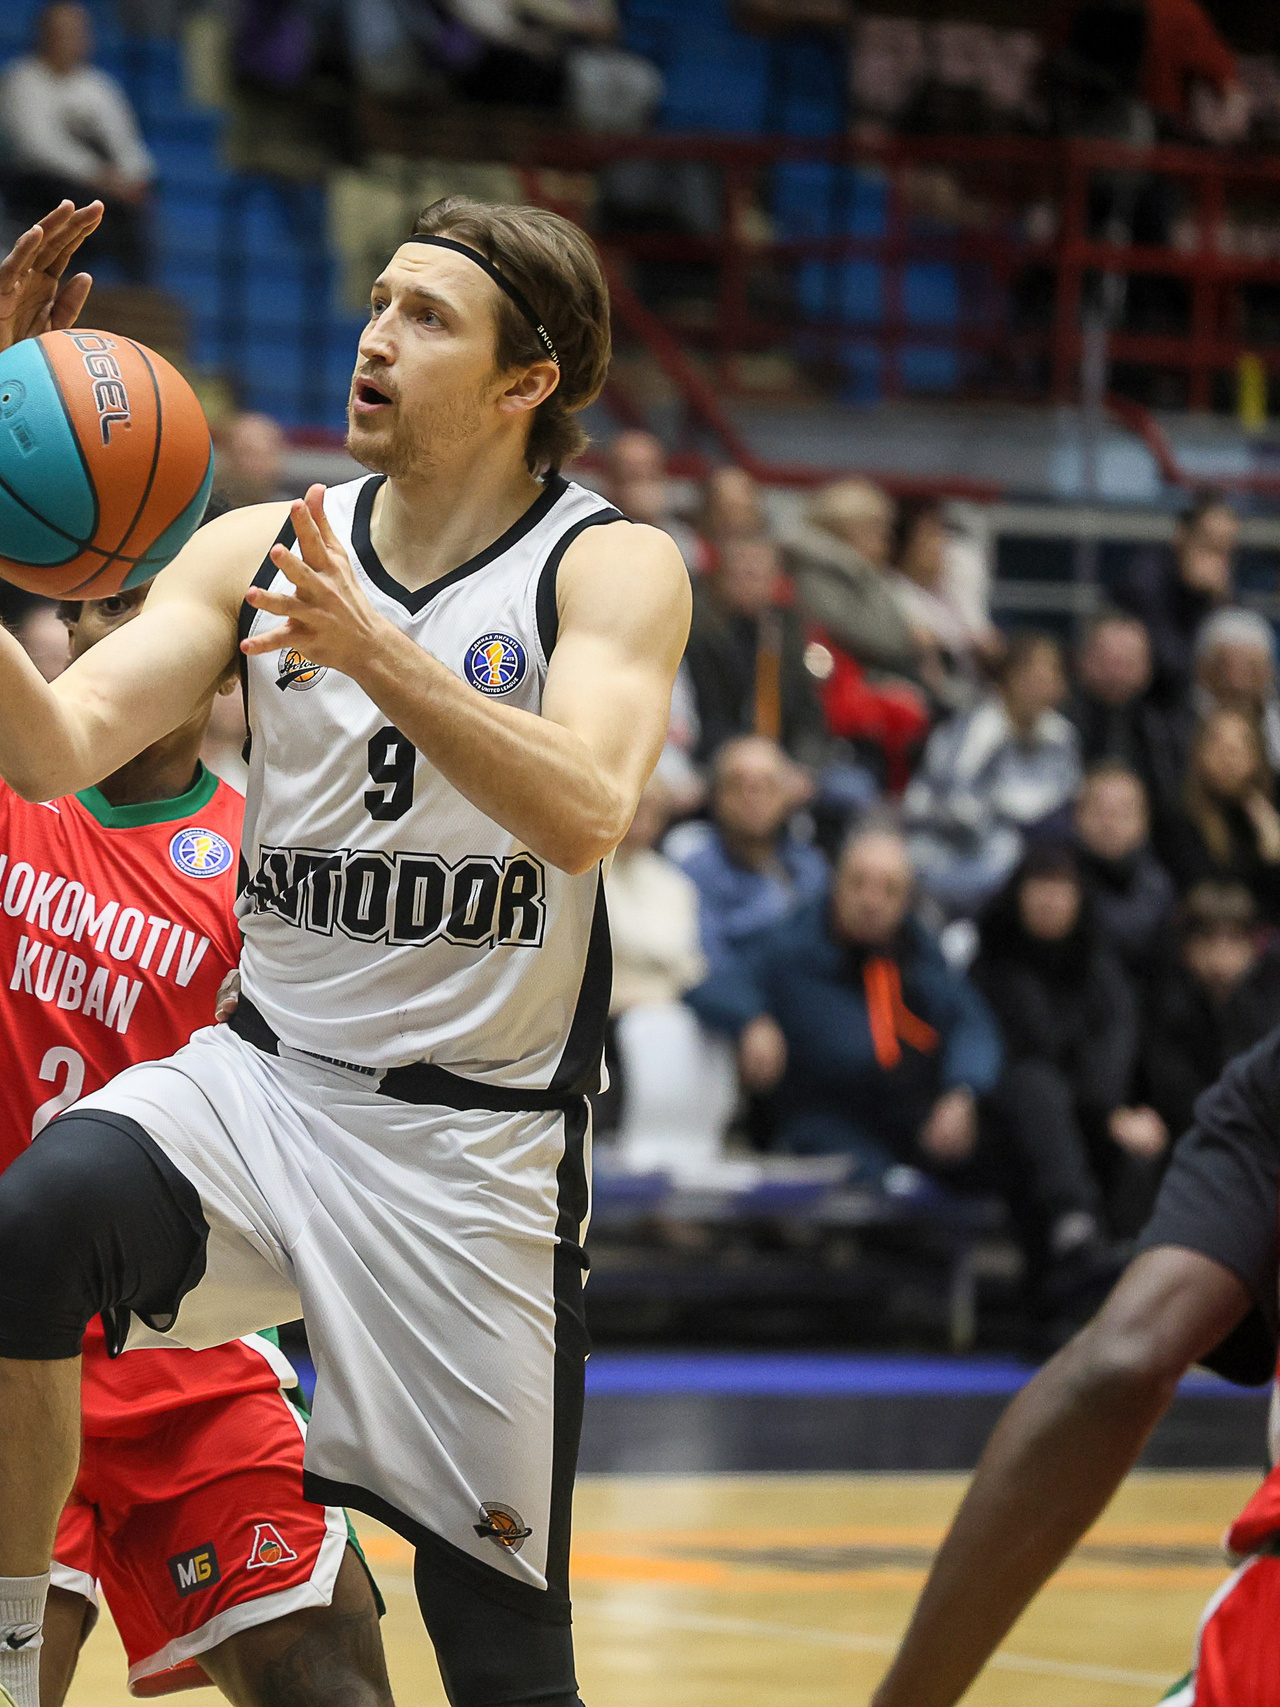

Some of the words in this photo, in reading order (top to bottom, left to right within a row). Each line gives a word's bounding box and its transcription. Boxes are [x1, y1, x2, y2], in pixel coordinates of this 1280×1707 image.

[500, 677, 519, 692] LEAGUE
[364, 725, 417, 821] 9
[9, 935, 144, 1035] KUBAN
[31, 1046, 86, 1141] 2
